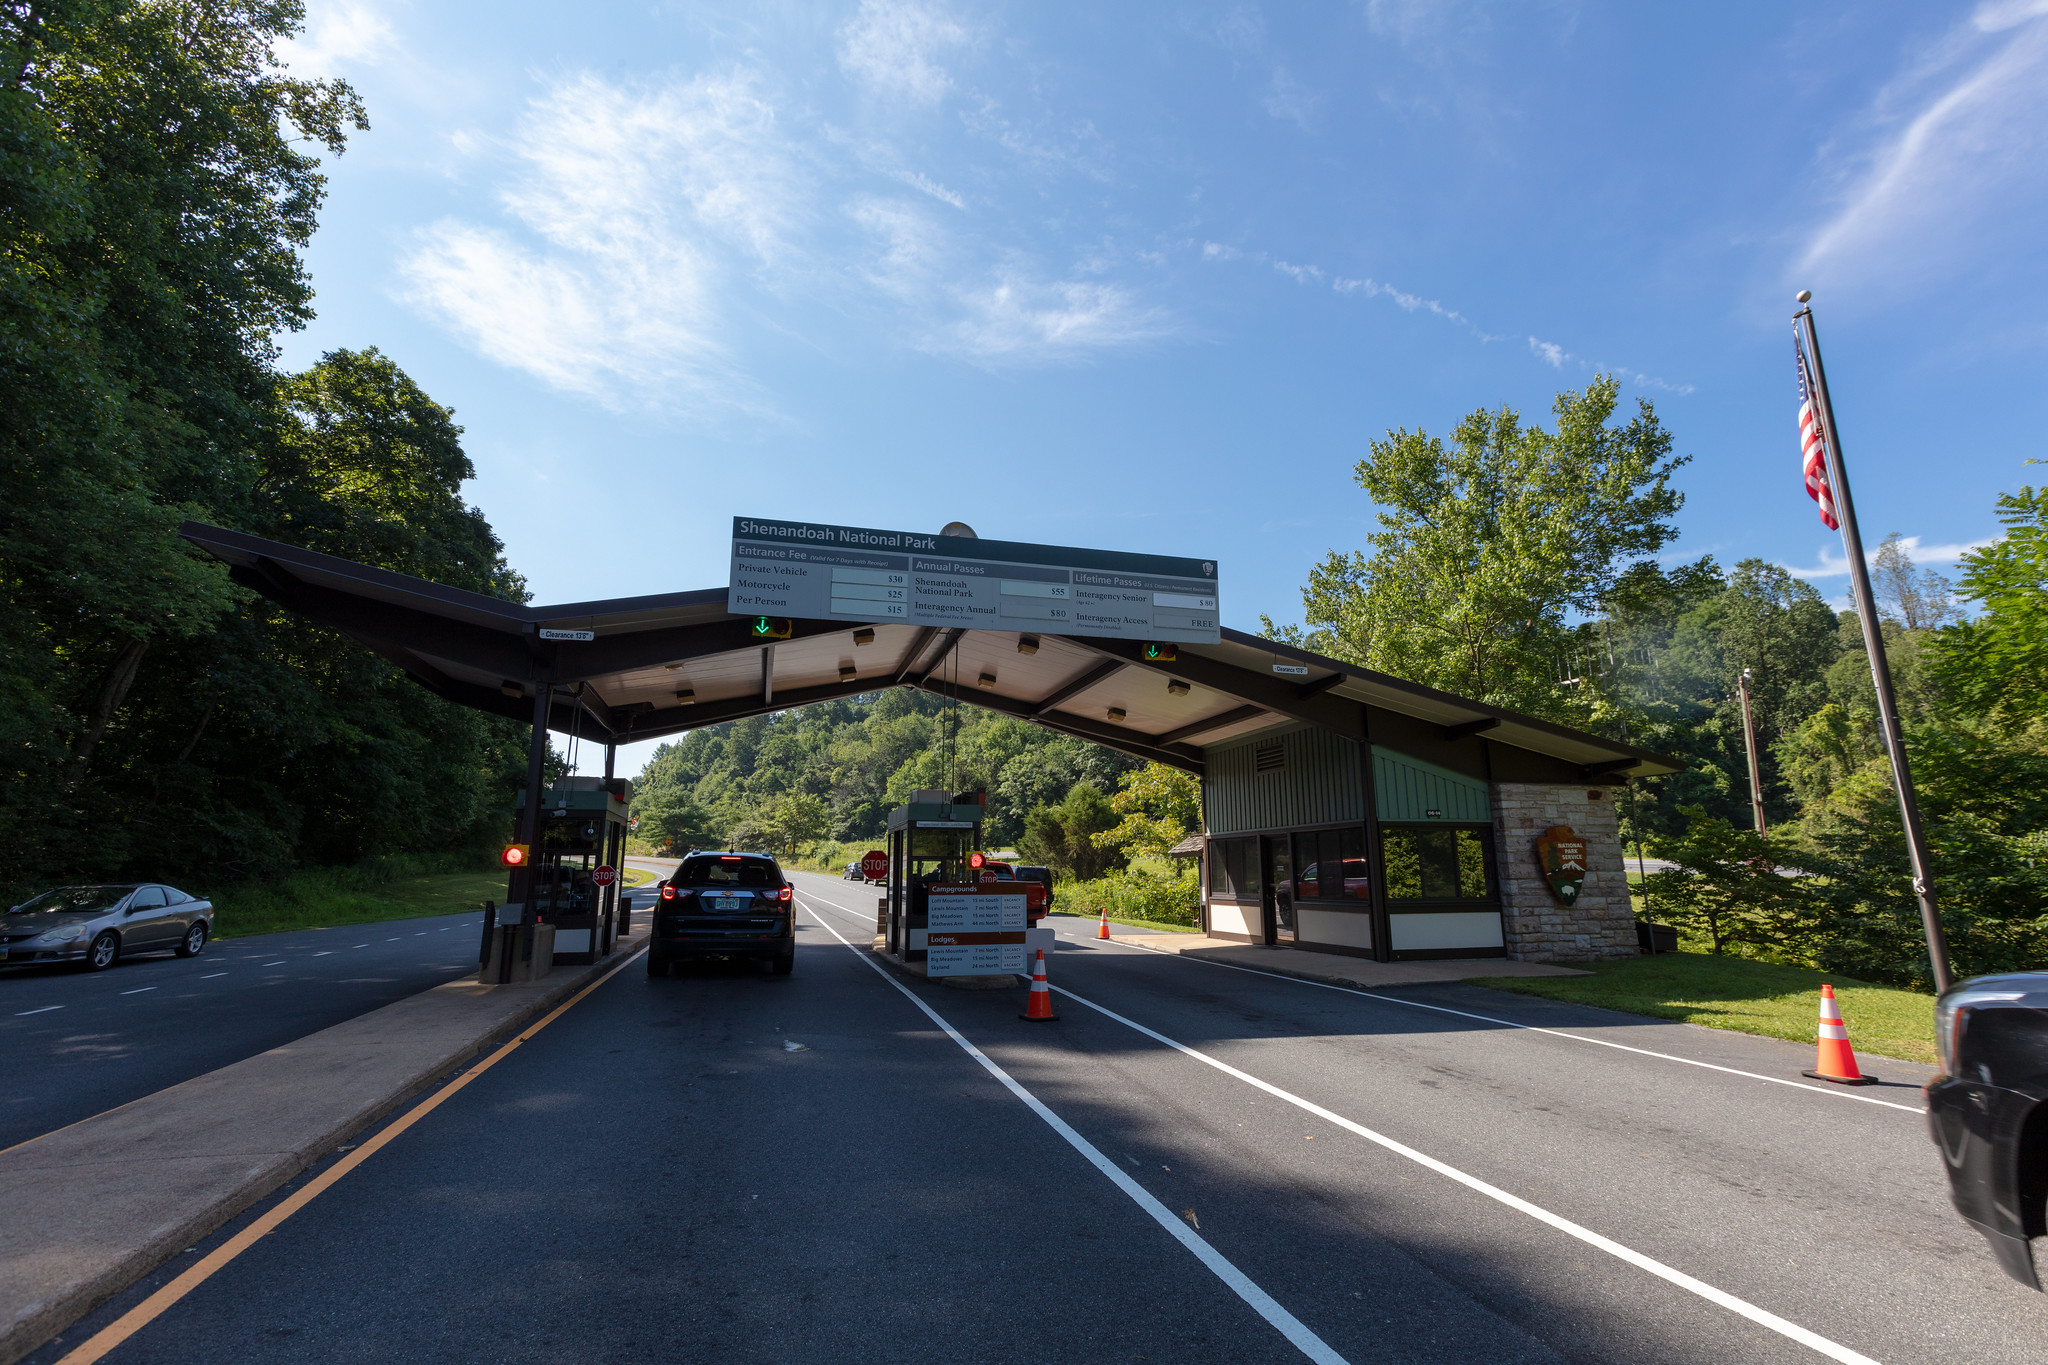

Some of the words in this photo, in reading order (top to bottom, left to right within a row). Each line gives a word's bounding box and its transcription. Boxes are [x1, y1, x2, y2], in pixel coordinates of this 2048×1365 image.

[740, 520, 834, 541] Shenandoah
[839, 530, 900, 546] National
[905, 536, 936, 550] Park
[738, 546, 786, 558] Entrance
[788, 550, 807, 560] Fee
[738, 564, 771, 574] Private
[773, 566, 808, 576] Vehicle
[916, 560, 951, 572] Annual
[954, 565, 985, 574] Passes
[738, 579, 790, 591] Motorcycle
[888, 575, 903, 584] $30
[915, 578, 967, 589] Shenandoah
[1075, 574, 1112, 585] Lifetime
[1114, 577, 1142, 587] Passes
[888, 590, 902, 599] $25
[915, 586, 952, 596] National
[954, 589, 974, 598] Park
[1051, 587, 1065, 596] $55
[1076, 590, 1121, 602] Interagency
[1122, 594, 1147, 603] Senior
[736, 595, 753, 604] Per
[754, 597, 787, 606] Person
[887, 605, 902, 614] $15
[915, 602, 965, 613] Interagency
[966, 605, 996, 614] Annual
[1050, 609, 1066, 618] $80
[1076, 613, 1121, 624] Interagency
[1123, 616, 1148, 625] Access
[1191, 619, 1214, 628] FREE
[863, 859, 888, 871] STOP
[595, 872, 615, 880] STOP
